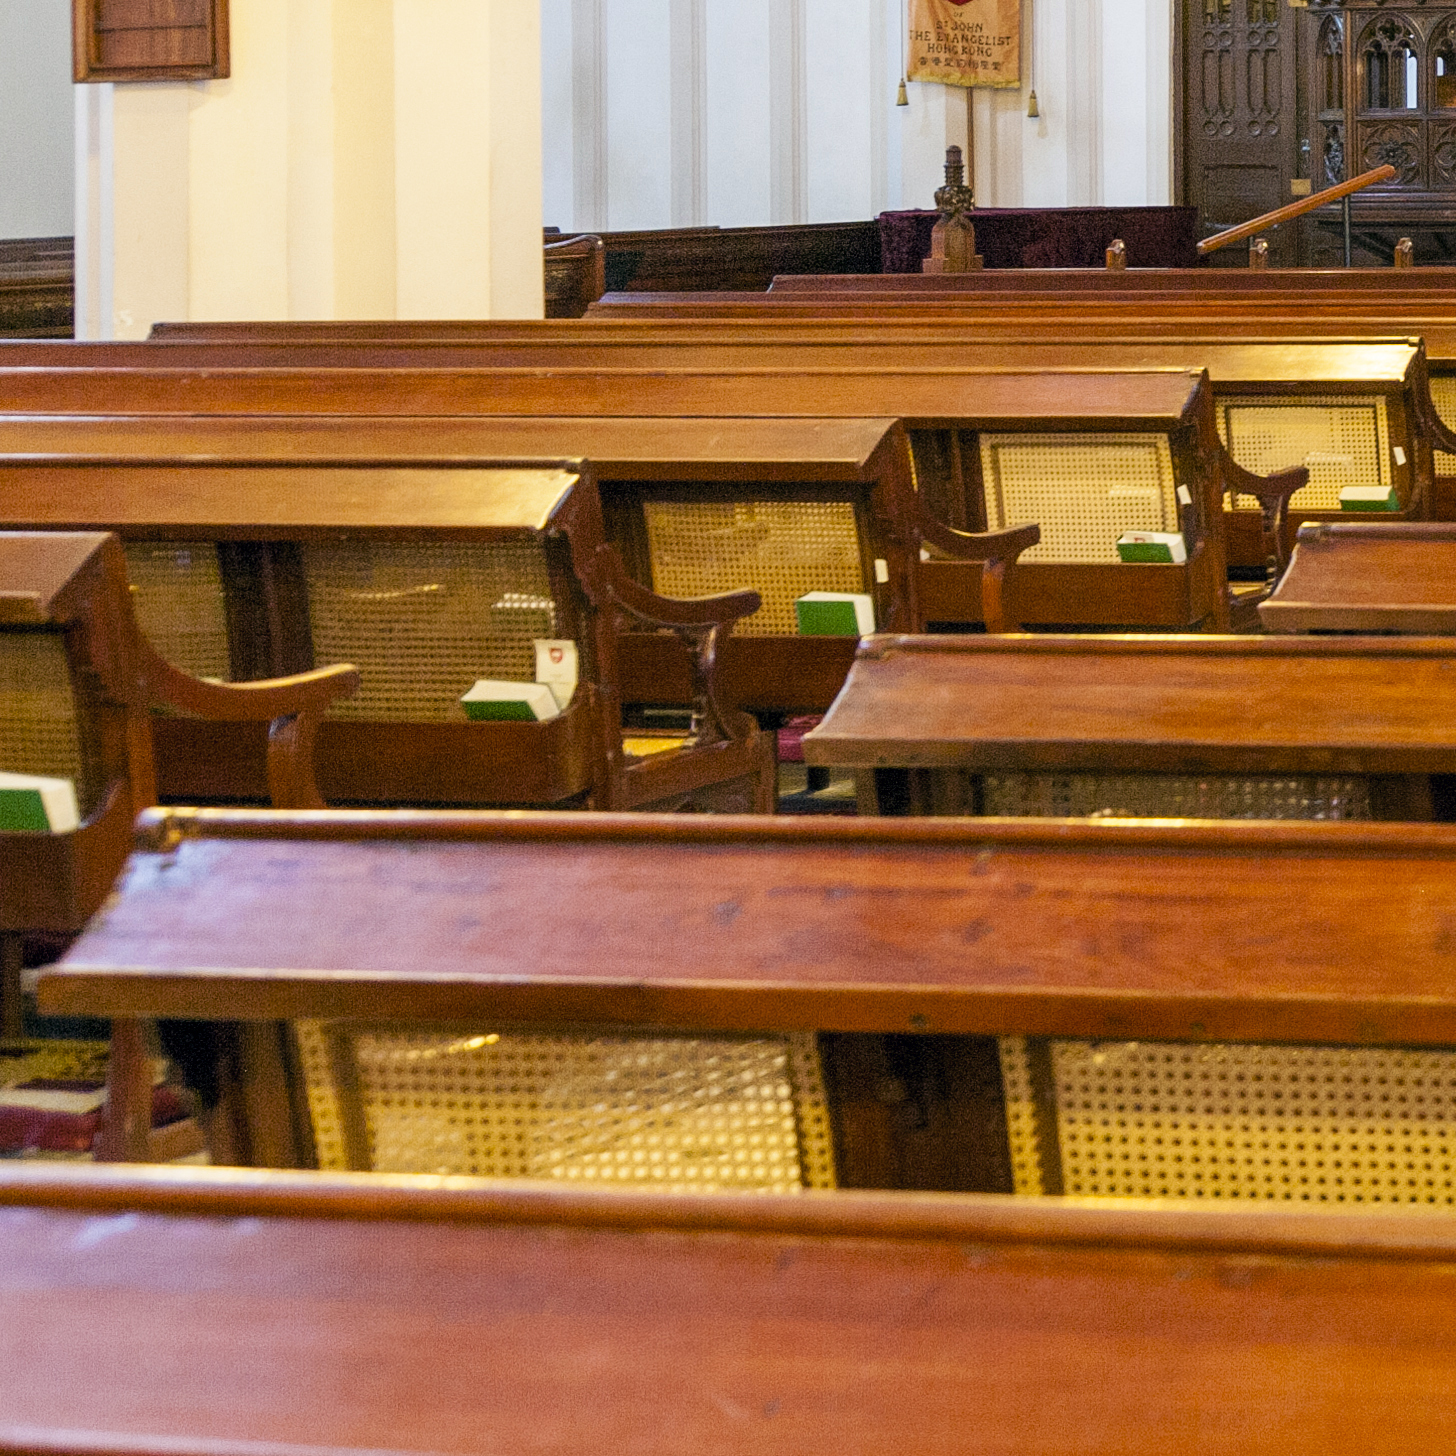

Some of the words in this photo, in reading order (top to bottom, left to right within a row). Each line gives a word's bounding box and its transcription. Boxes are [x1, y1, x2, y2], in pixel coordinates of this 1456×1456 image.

[951, 21, 983, 33] JOHN
[909, 30, 931, 41] THE
[936, 32, 1011, 46] EVANGELIST
[927, 43, 958, 55] HONG
[961, 45, 992, 57] KONG
